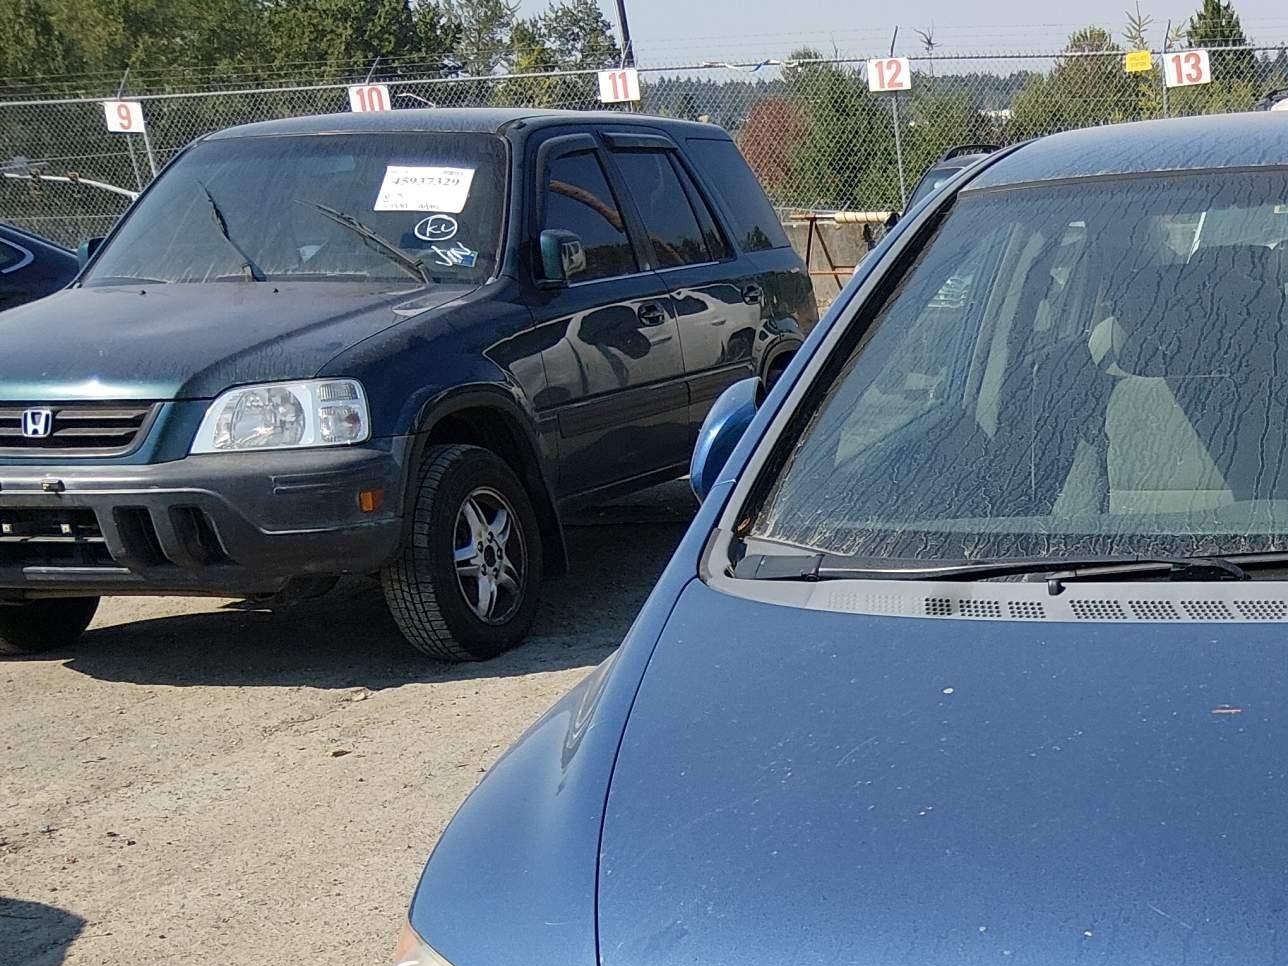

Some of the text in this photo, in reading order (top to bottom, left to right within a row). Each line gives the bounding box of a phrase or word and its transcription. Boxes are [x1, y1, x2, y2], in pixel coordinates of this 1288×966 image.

[874, 60, 904, 89] 12
[1171, 52, 1203, 84] 13
[355, 86, 386, 112] 10
[608, 71, 630, 100] 11
[117, 103, 133, 130] 9
